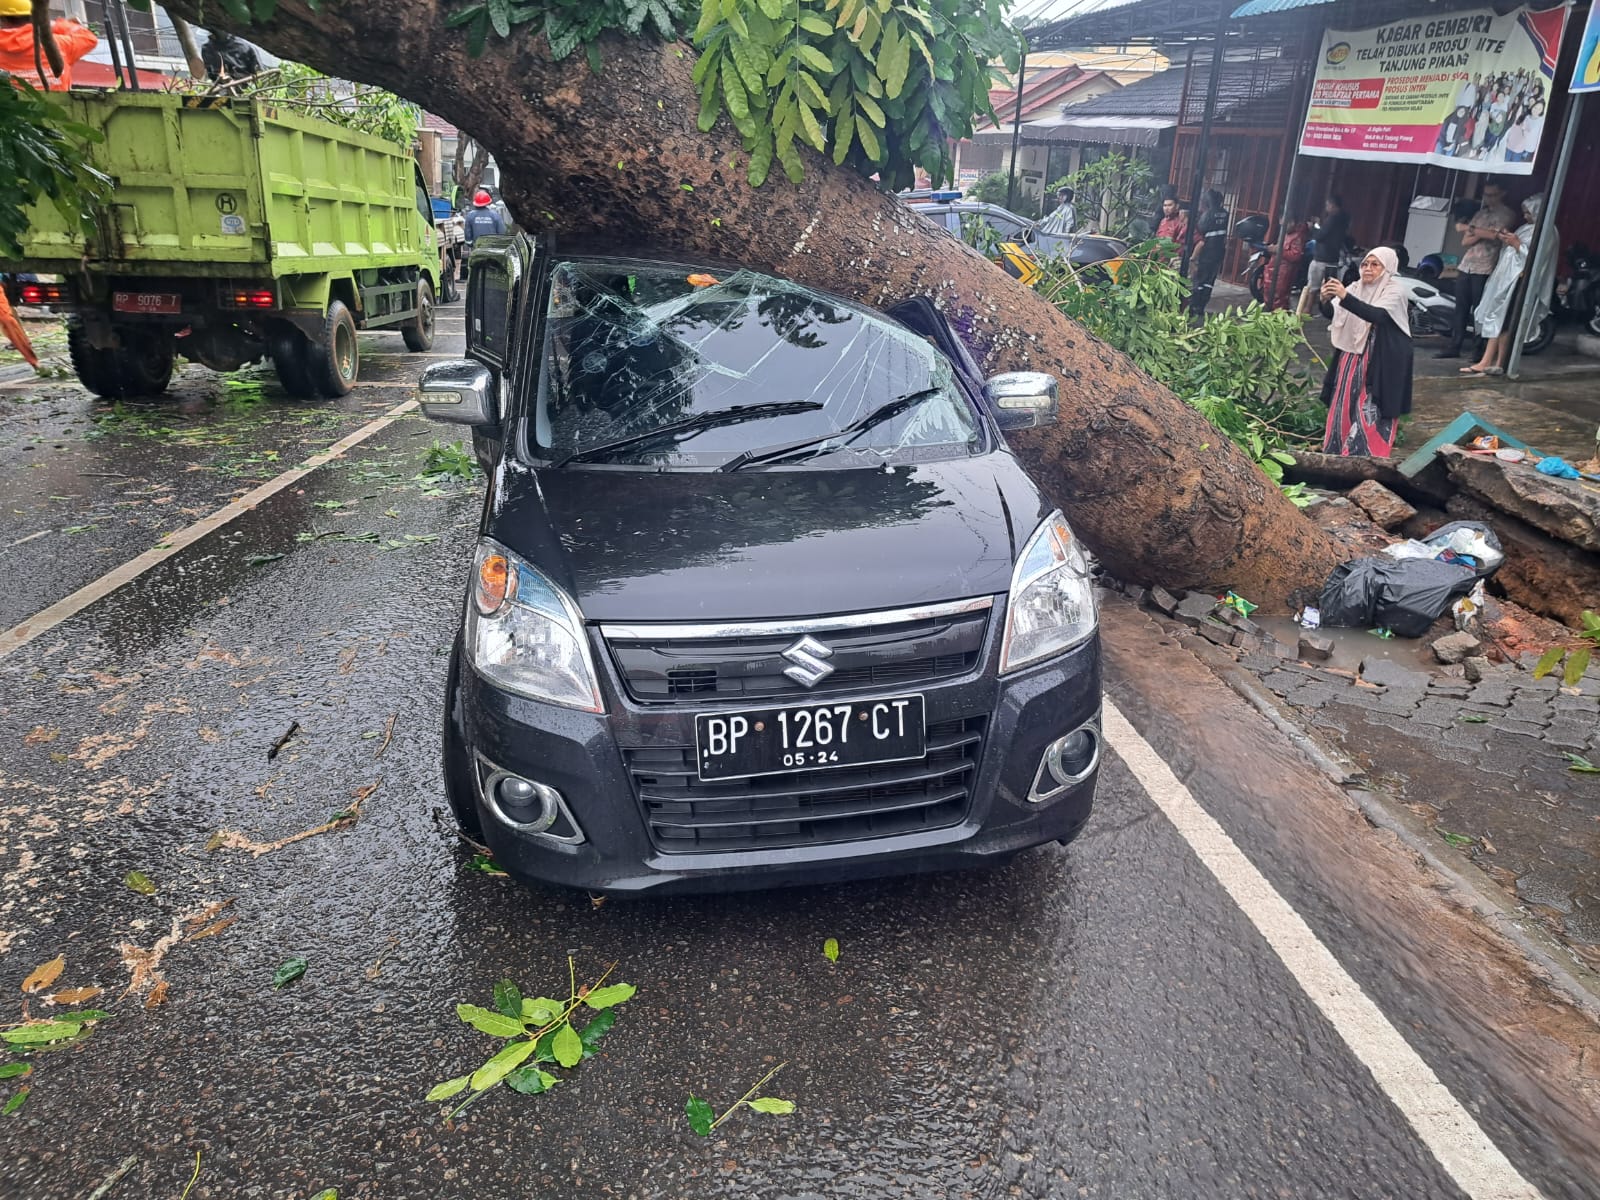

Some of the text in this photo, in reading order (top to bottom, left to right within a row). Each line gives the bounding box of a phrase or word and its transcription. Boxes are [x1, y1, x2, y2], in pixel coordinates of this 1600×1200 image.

[1376, 23, 1422, 44] KABAR
[1356, 46, 1385, 60] TELAH
[1387, 42, 1425, 58] DIBUKA
[1428, 37, 1471, 54] PROSU
[1379, 57, 1426, 73] TANJUNG
[1387, 75, 1419, 85] PROSEDUR
[1352, 90, 1380, 99] PERTAMA
[137, 294, 161, 306] 9076
[708, 700, 910, 756] BP 1267 CT
